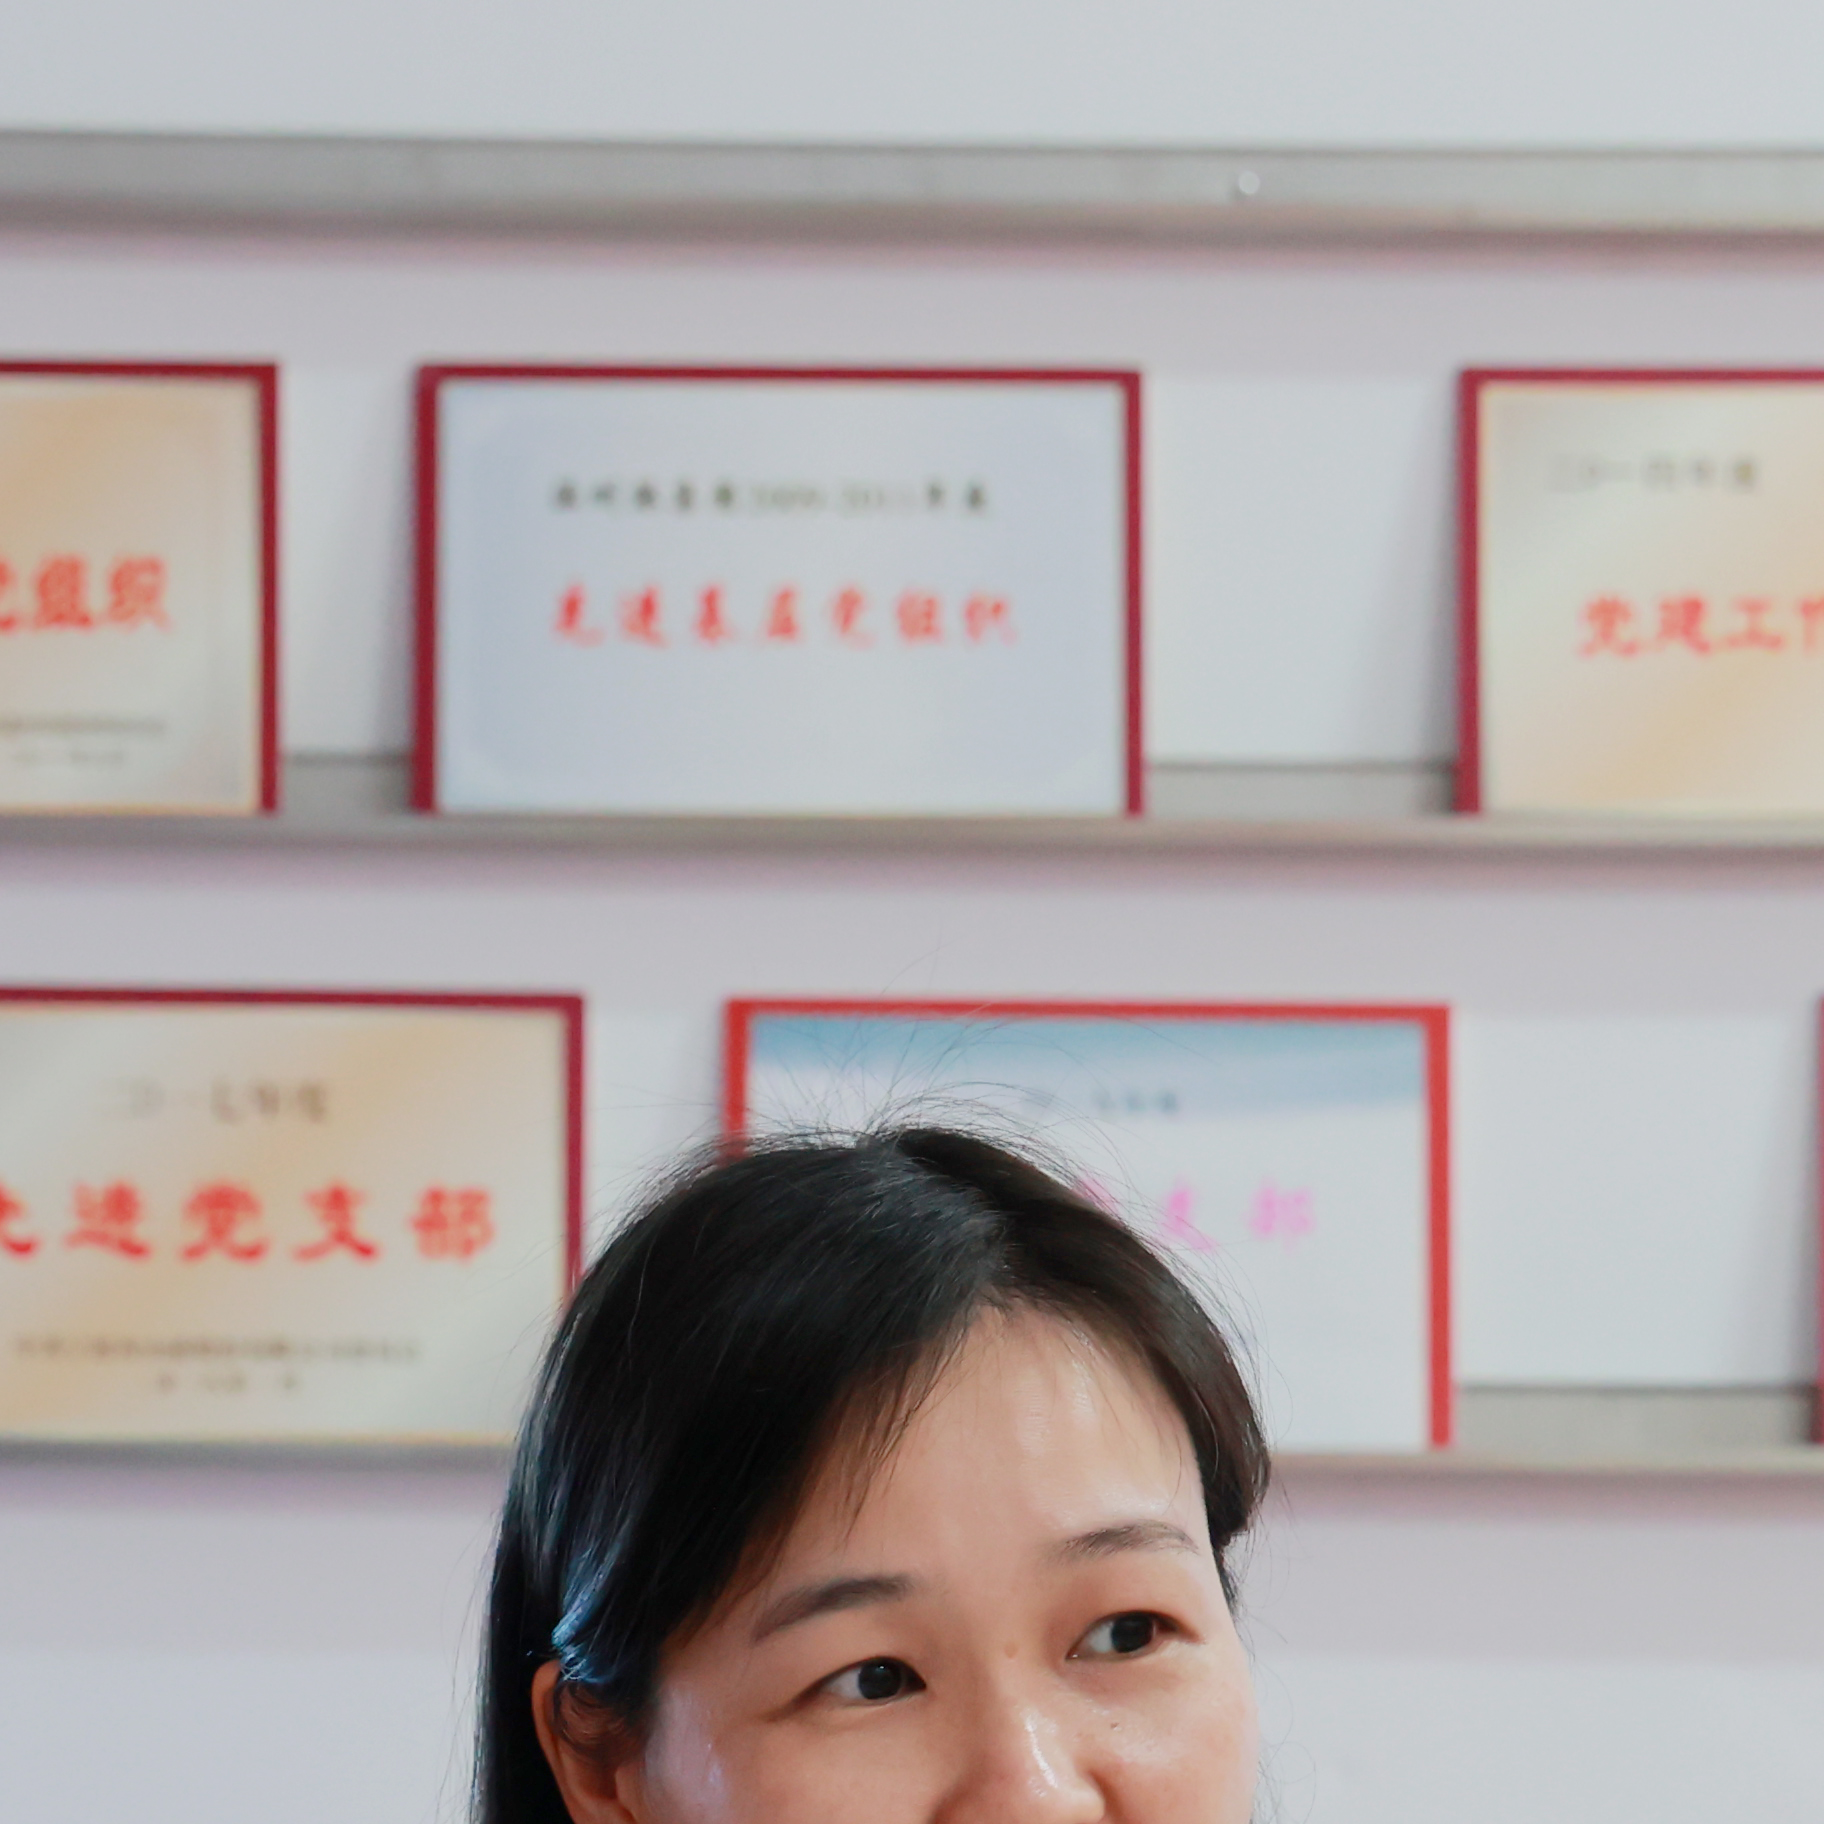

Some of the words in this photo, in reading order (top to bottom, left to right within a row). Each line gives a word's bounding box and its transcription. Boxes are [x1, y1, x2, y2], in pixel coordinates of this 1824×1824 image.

[550, 581, 1018, 650] 先进基层党组织
